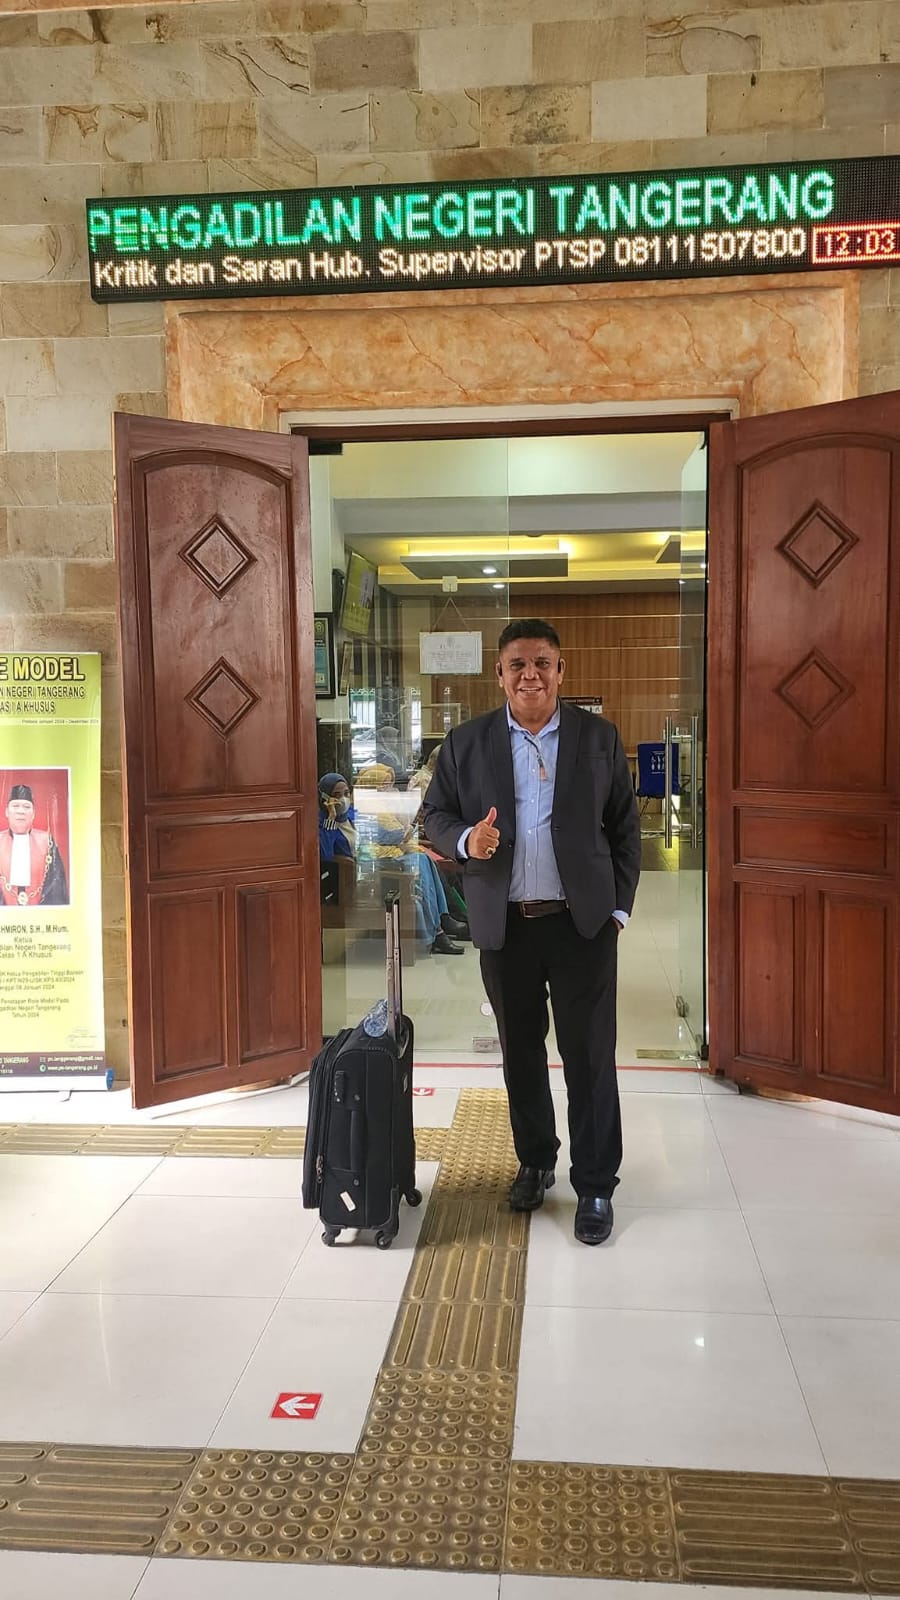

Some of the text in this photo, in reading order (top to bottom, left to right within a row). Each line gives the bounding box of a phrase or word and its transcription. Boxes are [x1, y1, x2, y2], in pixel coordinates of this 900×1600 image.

[89, 170, 835, 253] PENGADILAN NEGERI TANGERANG
[824, 230, 897, 258] 12:03
[95, 228, 806, 288] Kritik dan Saran Hub. Supervisor PTSP 08111507800
[13, 657, 86, 681] MODEL
[7, 686, 36, 698] NEGERI
[37, 686, 85, 698] TANGERANG
[23, 701, 56, 713] KHUSUS
[38, 943, 72, 952] Tangerang
